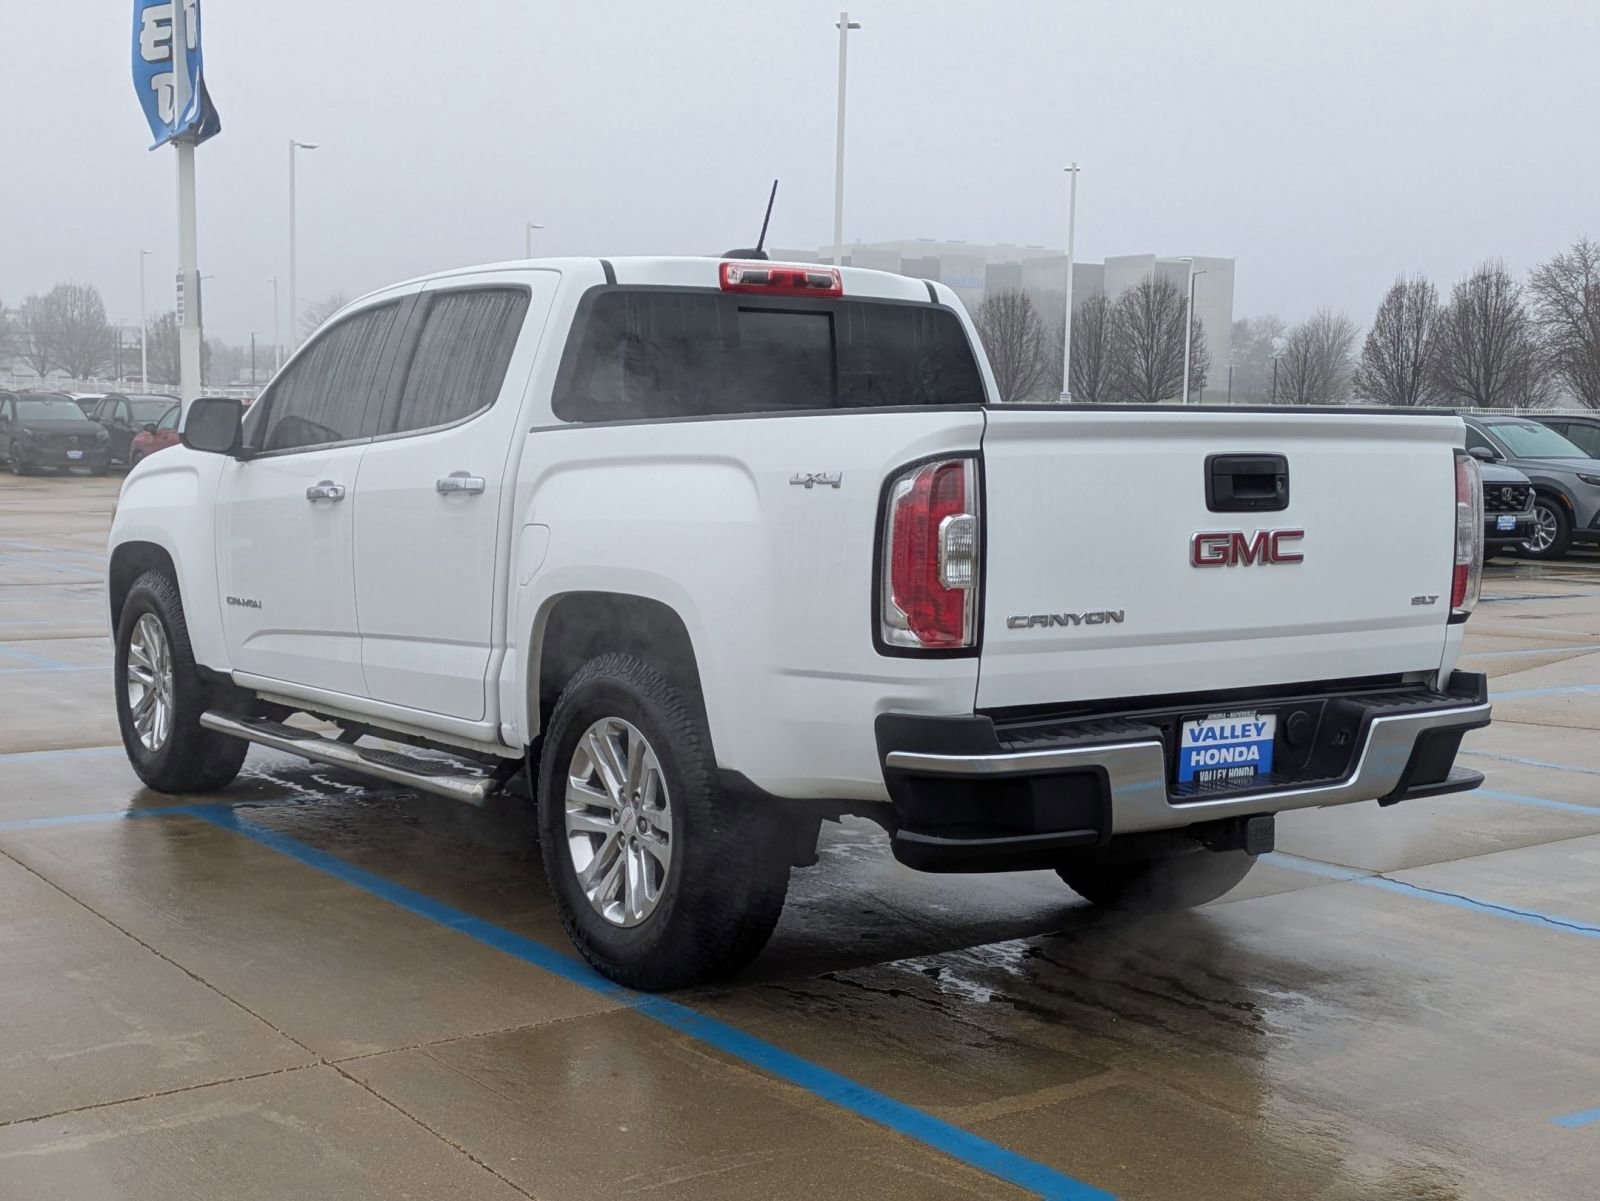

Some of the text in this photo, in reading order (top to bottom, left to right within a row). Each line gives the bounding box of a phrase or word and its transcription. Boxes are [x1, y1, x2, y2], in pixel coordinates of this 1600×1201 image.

[1190, 529, 1305, 568] GMC
[1410, 595, 1440, 606] SLT
[1007, 609, 1125, 629] CANYON
[1189, 721, 1267, 743] VALLEY
[1190, 745, 1260, 767] HONDA
[1200, 766, 1255, 782] VALLEY HONDA
